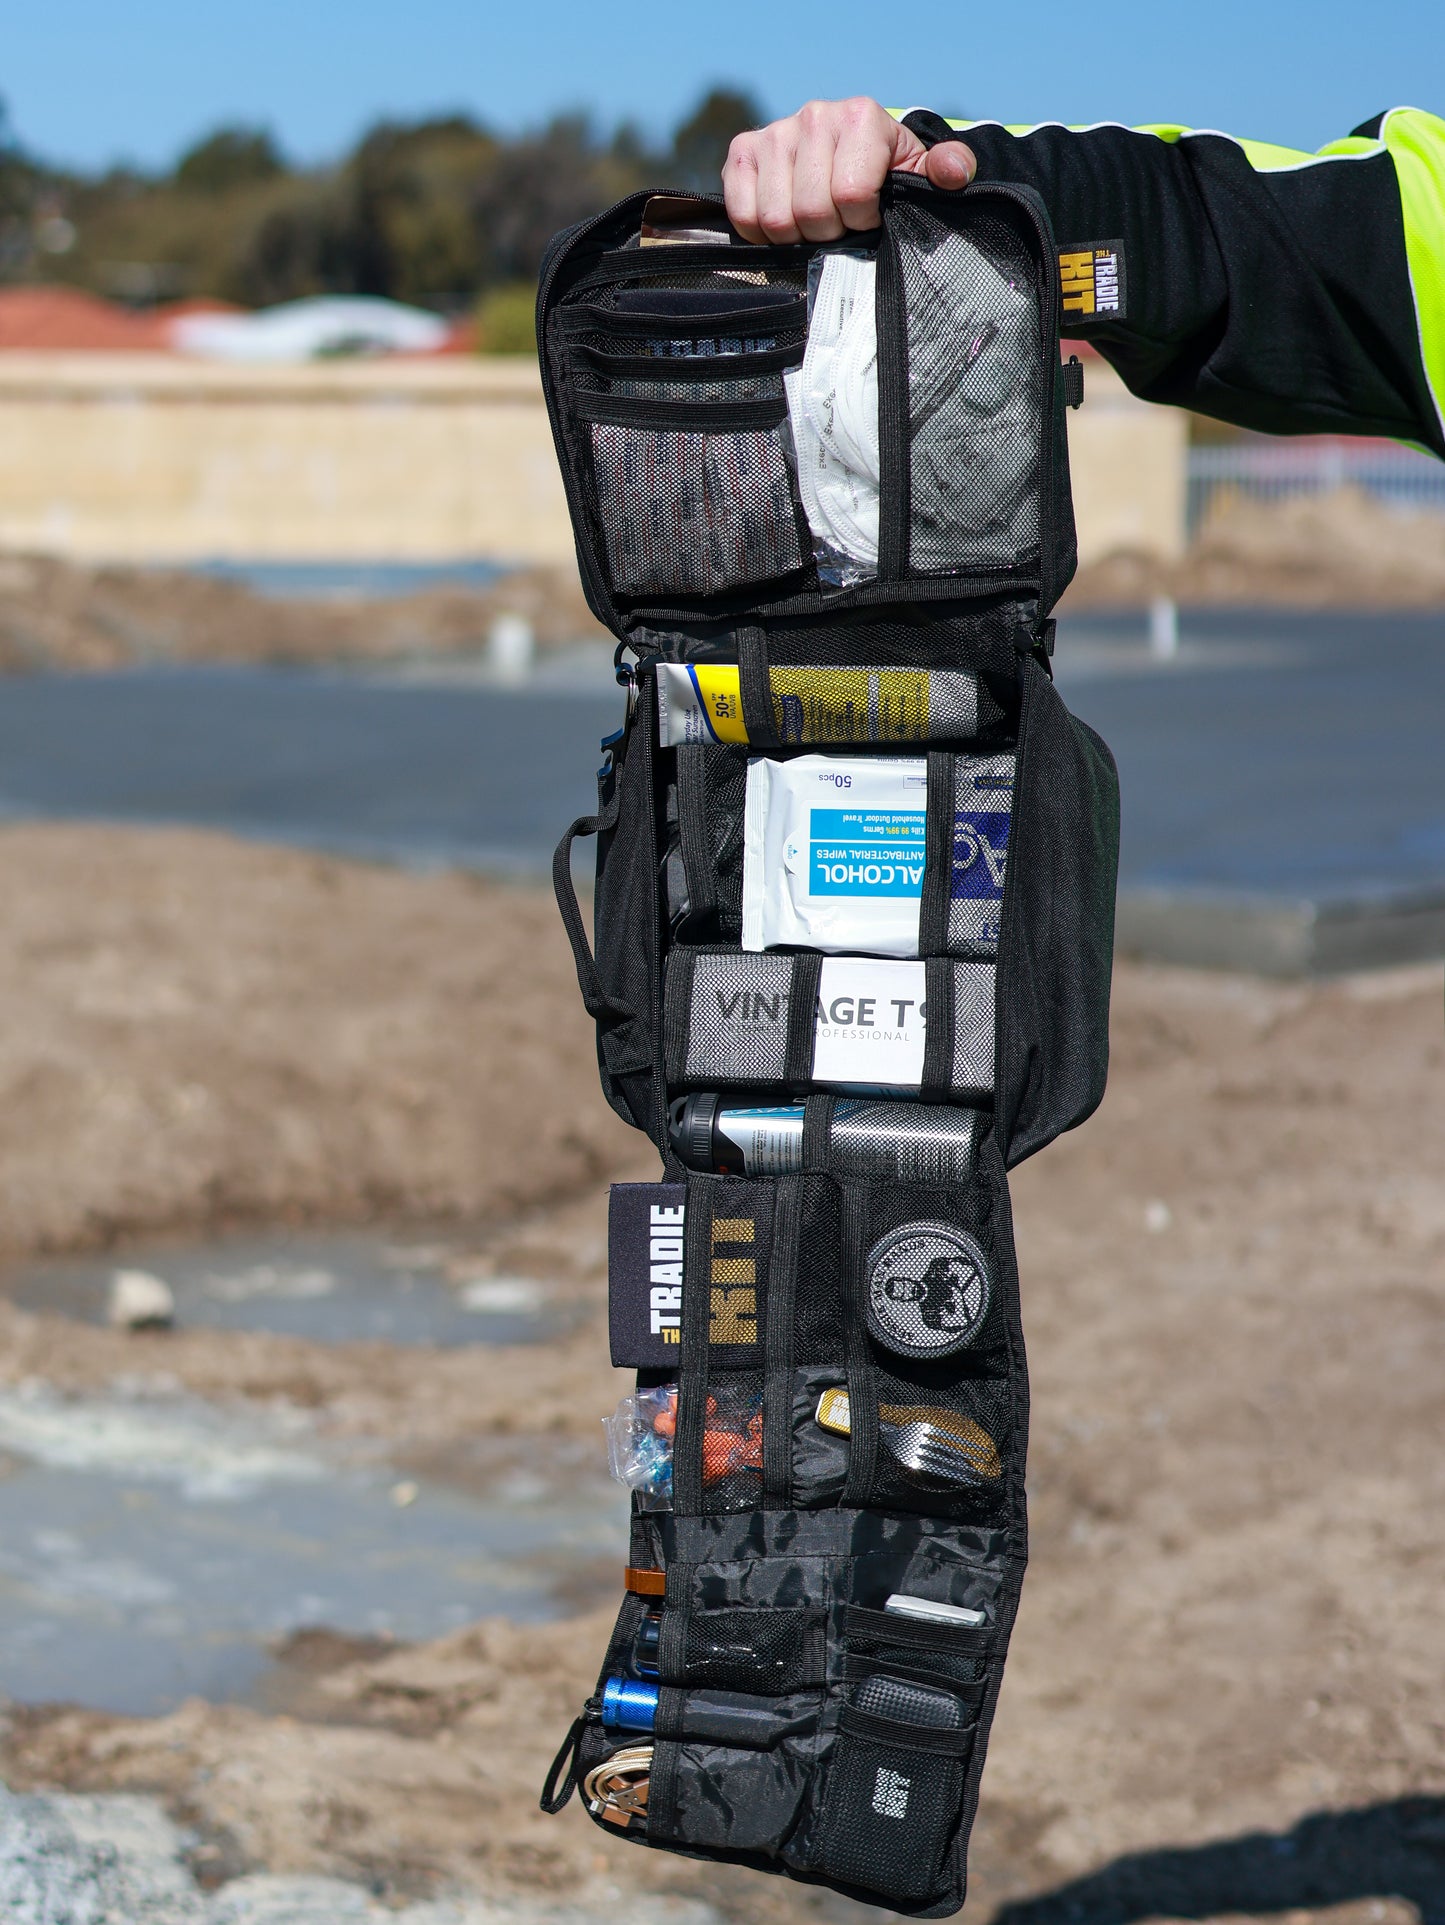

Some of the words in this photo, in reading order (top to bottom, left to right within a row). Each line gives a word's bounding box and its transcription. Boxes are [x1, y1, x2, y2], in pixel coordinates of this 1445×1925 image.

[1095, 249, 1111, 258] THE
[1059, 251, 1095, 315] KIT
[1095, 253, 1119, 312] TRADIE
[715, 694, 730, 718] 50+
[818, 773, 852, 788] 50pcs
[843, 814, 862, 823] Travel
[865, 815, 891, 824] Outdoor
[892, 815, 925, 824] Household
[863, 826, 885, 834] Germs
[886, 826, 909, 835] 99.99%
[911, 826, 925, 835] Kills
[816, 849, 847, 860] WIPES
[849, 850, 925, 861] ANTIBACTERIAL
[817, 864, 924, 885] ALCOHOL
[814, 1028, 910, 1042] ROFESSIONAL
[650, 1205, 685, 1334] TRADIE
[709, 1207, 757, 1345] KIT
